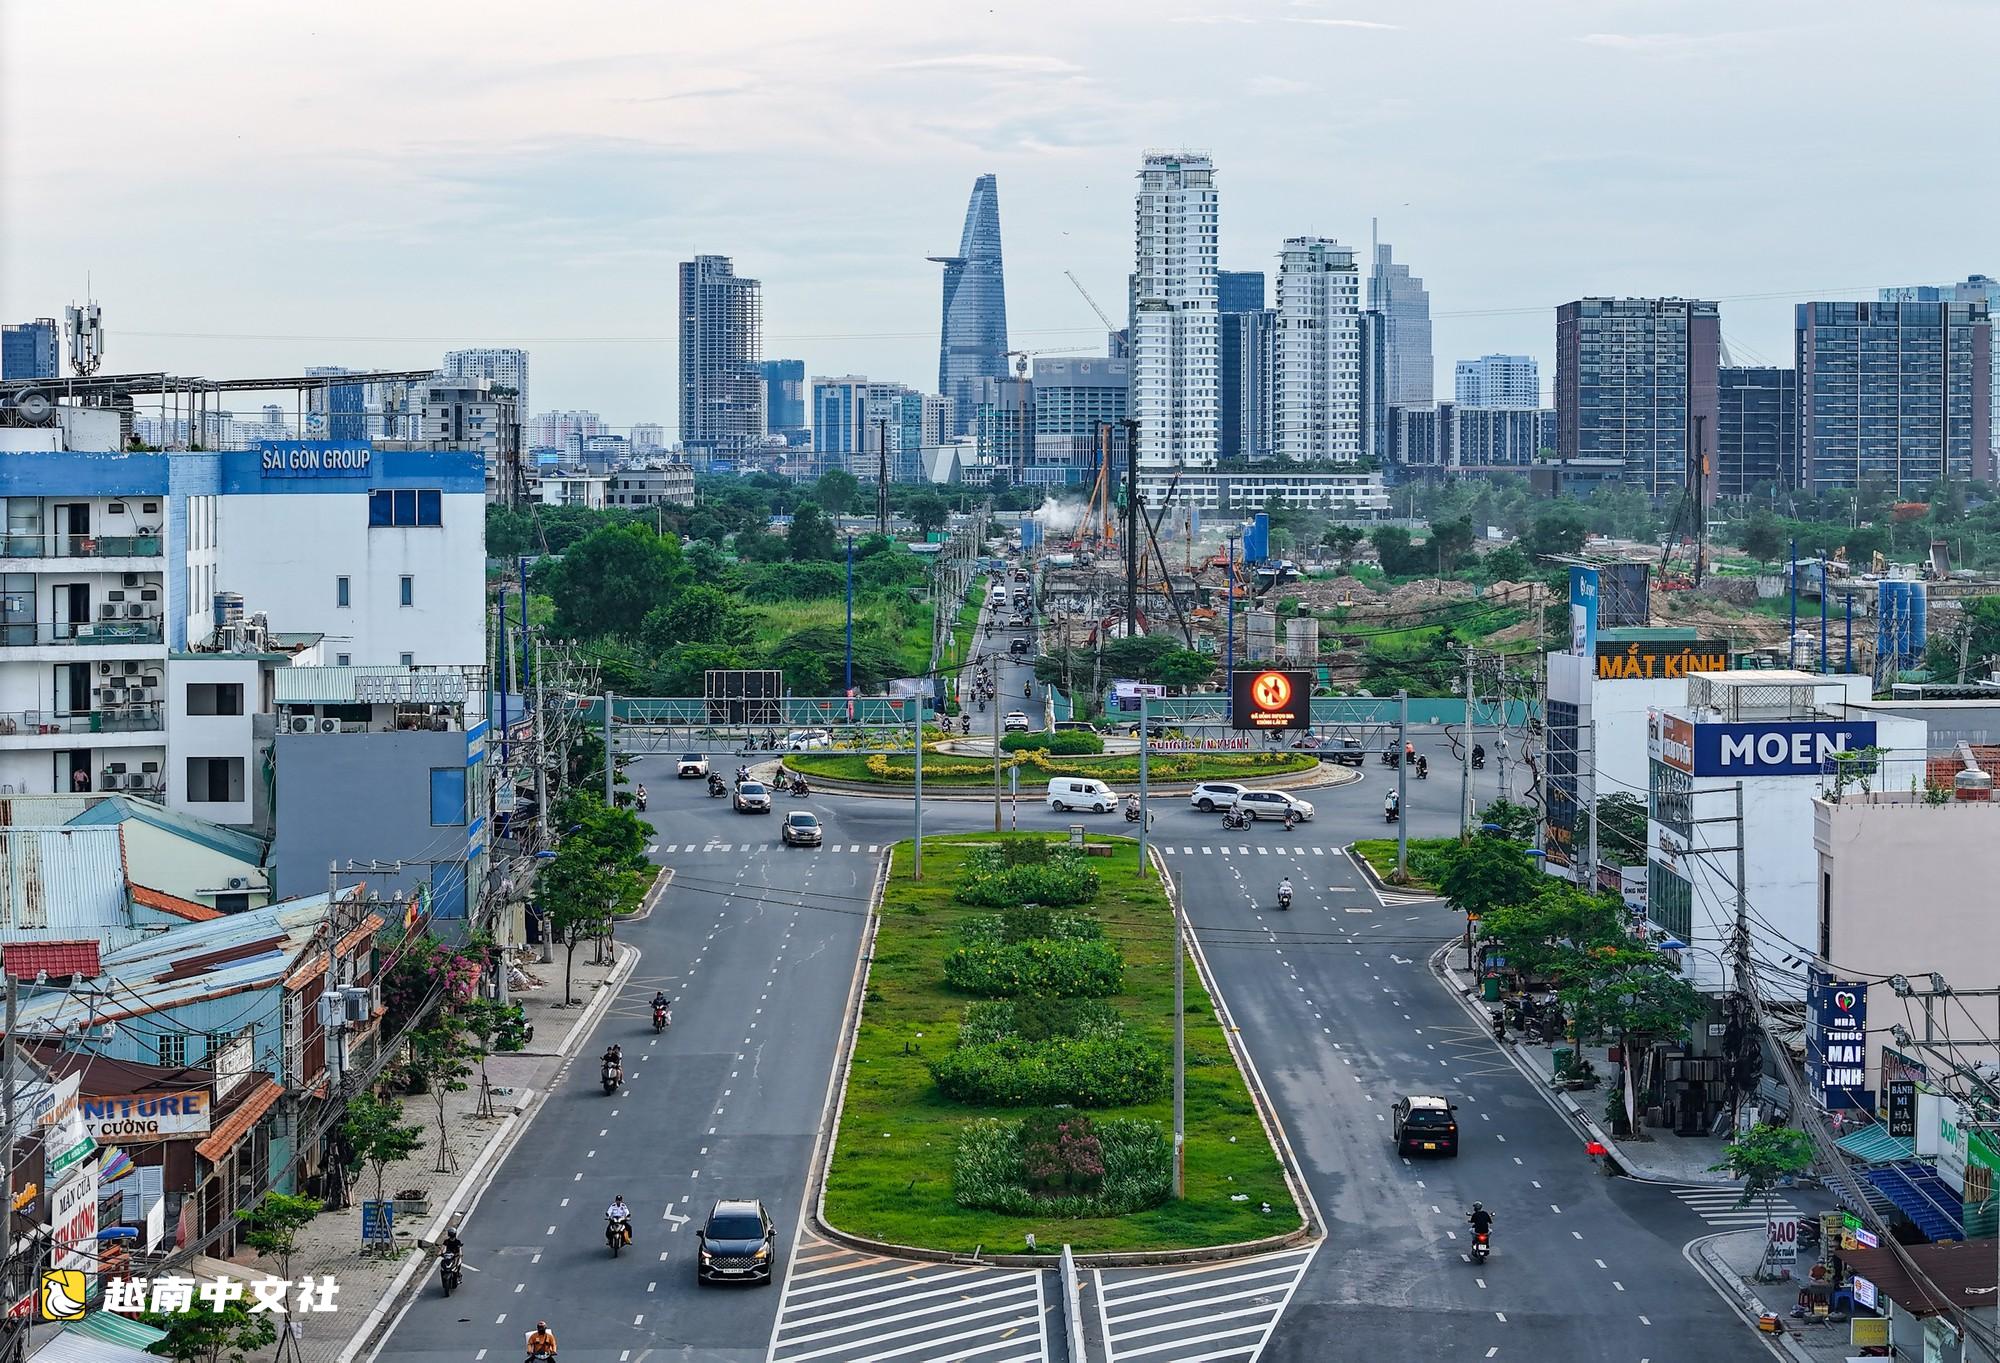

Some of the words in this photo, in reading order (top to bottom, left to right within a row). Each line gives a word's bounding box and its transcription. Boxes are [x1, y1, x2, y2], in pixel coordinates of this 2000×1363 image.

[263, 444, 286, 469] SÀI
[289, 444, 320, 469] GÒN
[323, 449, 370, 469] GROUP
[1599, 642, 1656, 678] MẮT
[1664, 647, 1726, 678] KÍNH
[411, 674, 467, 702] KHOA
[1720, 732, 1846, 766] MOEN
[1834, 1014, 1857, 1027] NHÀ
[1827, 1045, 1862, 1063] MAI
[1825, 1068, 1862, 1086] LINH
[1891, 1083, 1913, 1094] BÁNH
[79, 1096, 201, 1120] NITURE
[101, 1119, 159, 1136] CƯỜNG
[59, 1189, 75, 1216] MÀN
[54, 1222, 70, 1266] KIM
[1767, 1221, 1796, 1245] GẠO
